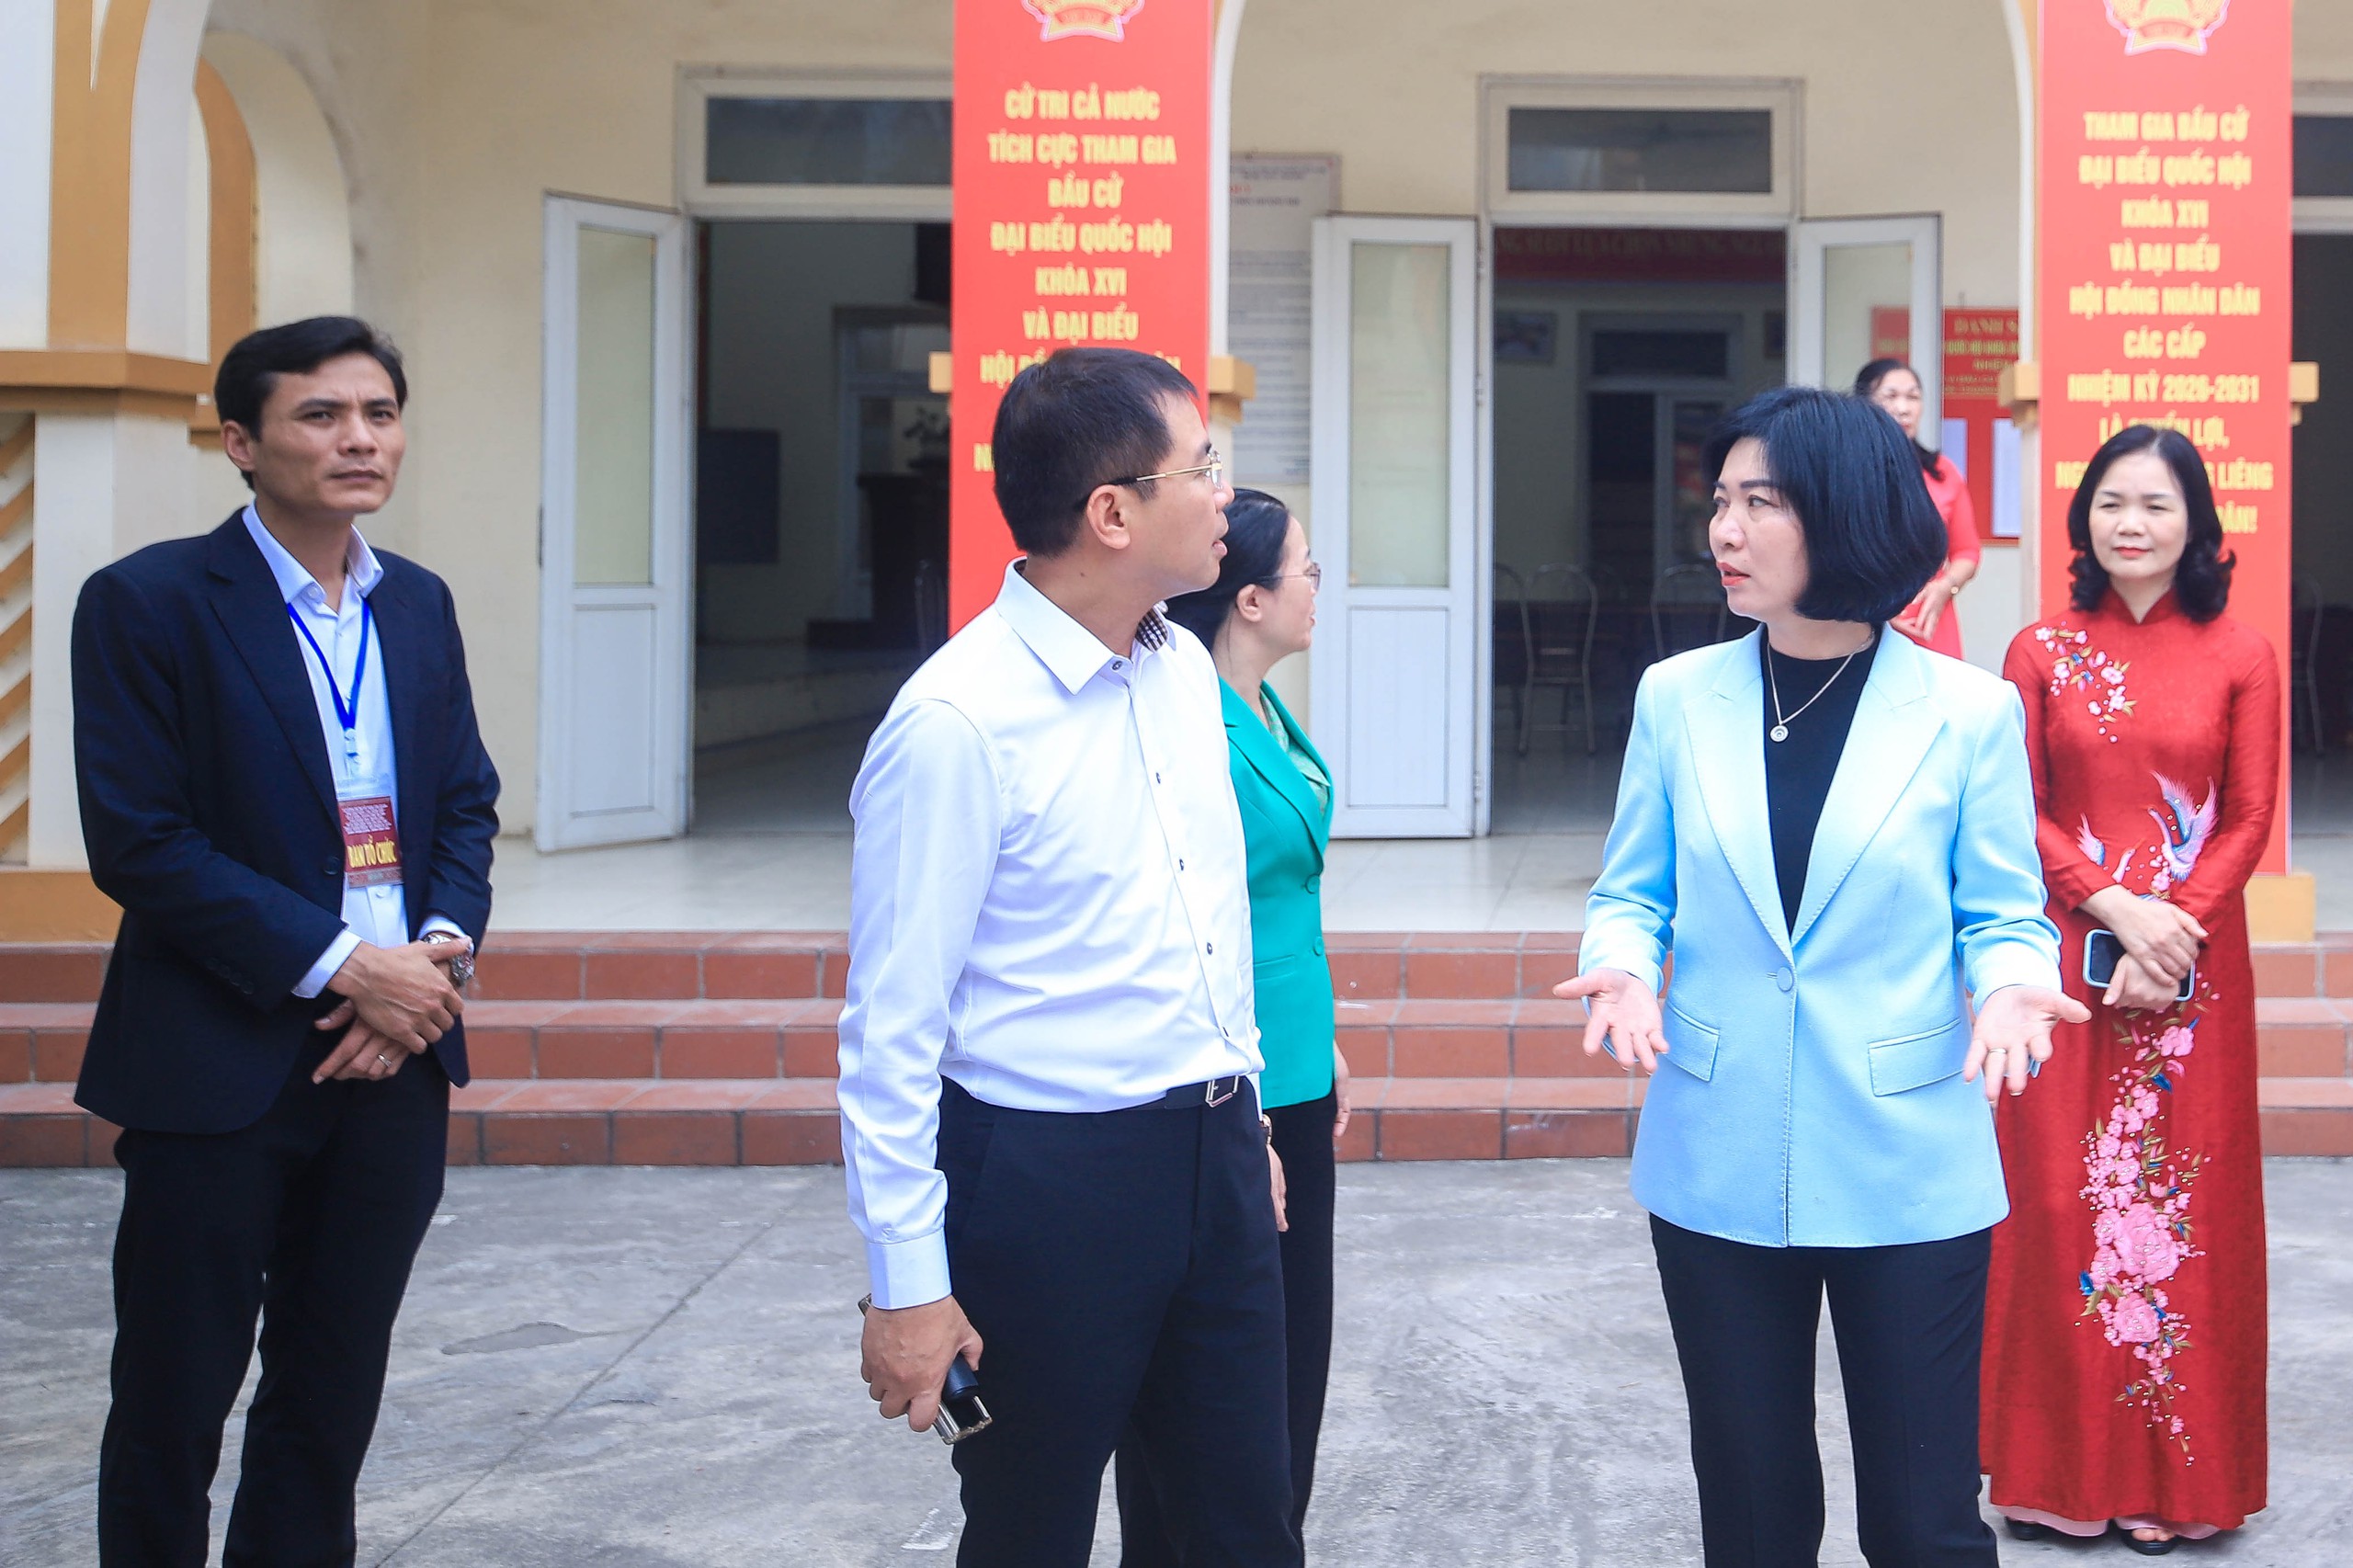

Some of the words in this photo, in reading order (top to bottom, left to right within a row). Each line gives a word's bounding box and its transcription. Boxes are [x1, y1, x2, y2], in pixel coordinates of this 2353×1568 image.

[1005, 81, 1037, 119] CỬ
[1038, 89, 1070, 119] TRI
[1072, 82, 1102, 120] CẢ
[1104, 85, 1161, 120] NƯỚC
[2083, 111, 2139, 141] THAM
[2141, 111, 2176, 141] GIA
[2177, 104, 2218, 142] BẦU
[2219, 104, 2250, 142] CỬ
[988, 129, 1034, 163] TÍCH
[1036, 132, 1078, 169] CỰC
[1081, 134, 1139, 164] THAM
[1141, 135, 1177, 165] GIA
[2078, 154, 2113, 189] ĐẠI
[2115, 145, 2161, 185] BIỂU
[2162, 147, 2216, 187] QUỐC
[2217, 151, 2252, 190] HỘI
[1048, 170, 1090, 208] BẦU
[1092, 170, 1124, 208] CỬ
[2176, 199, 2209, 228] XVI
[990, 221, 1027, 256] ĐẠI
[1029, 212, 1076, 252] BIỂU
[1078, 214, 1134, 255] QUỐC
[1136, 218, 1173, 258] HỘI
[2109, 237, 2137, 271] VÀ
[2138, 243, 2173, 277] ĐẠI
[2174, 233, 2221, 272] BIỂU
[1093, 267, 1128, 296] XVI
[2069, 280, 2104, 320] HỘI
[2105, 278, 2160, 315] ĐỒNG
[2161, 281, 2218, 315] NHÂN
[2219, 281, 2261, 316] DÂN
[1022, 305, 1051, 339] VÀ
[1052, 311, 1089, 346] ĐẠI
[1091, 301, 1140, 341] BIỂU
[2123, 324, 2165, 358] CÁC
[2165, 322, 2207, 358] CẤP
[980, 348, 1016, 389] HỘI
[2067, 368, 2131, 407] NHIỆM
[2132, 369, 2160, 402] KỲ
[2217, 456, 2275, 491] LIÊNG
